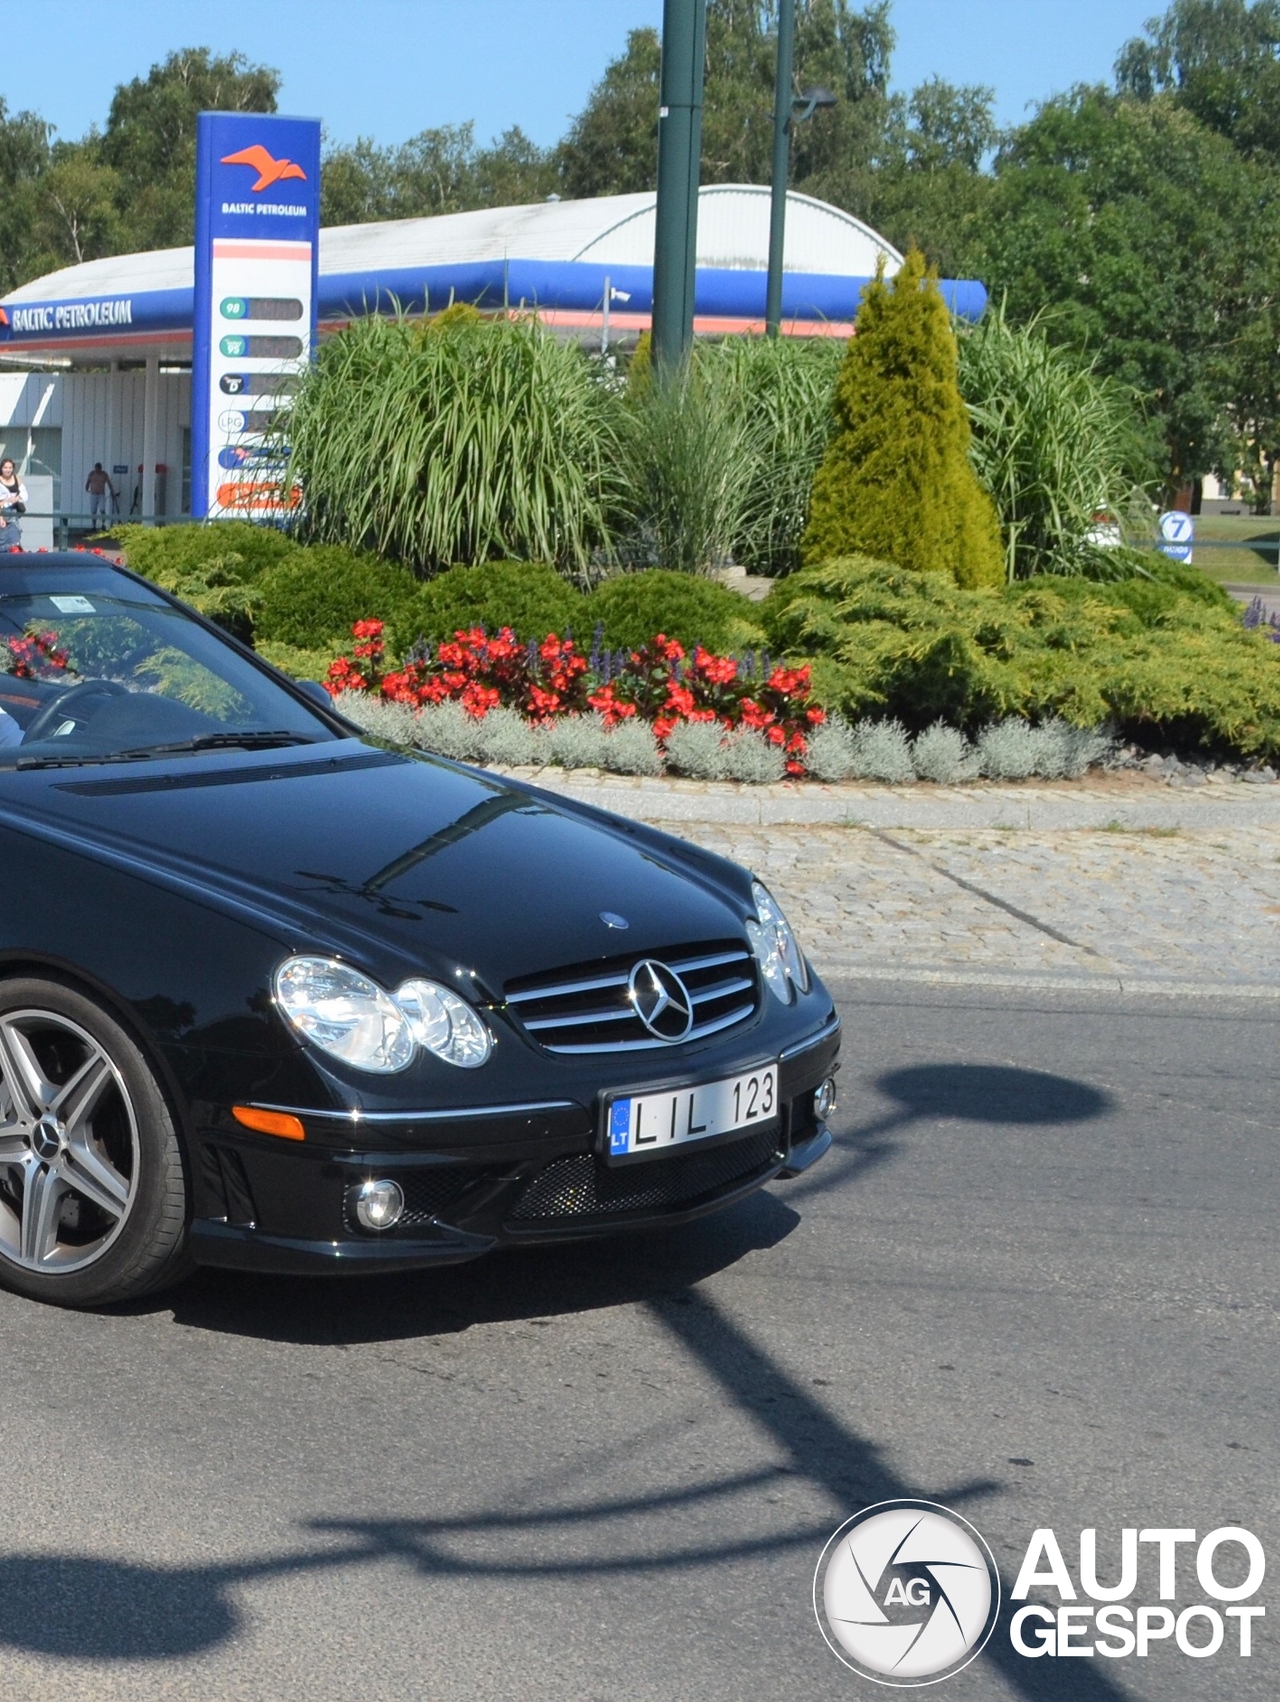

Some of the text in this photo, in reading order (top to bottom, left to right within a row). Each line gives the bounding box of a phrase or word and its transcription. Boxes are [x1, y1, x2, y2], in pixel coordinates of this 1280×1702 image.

[222, 202, 307, 217] BALTIC PETROLEUM
[12, 299, 132, 332] BALTIC PETROLEUM
[226, 303, 240, 314] 98
[229, 382, 239, 393] D
[221, 417, 242, 428] LPG
[1172, 519, 1185, 538] 7
[635, 1072, 773, 1145] LIL 123
[611, 1132, 627, 1146] LT
